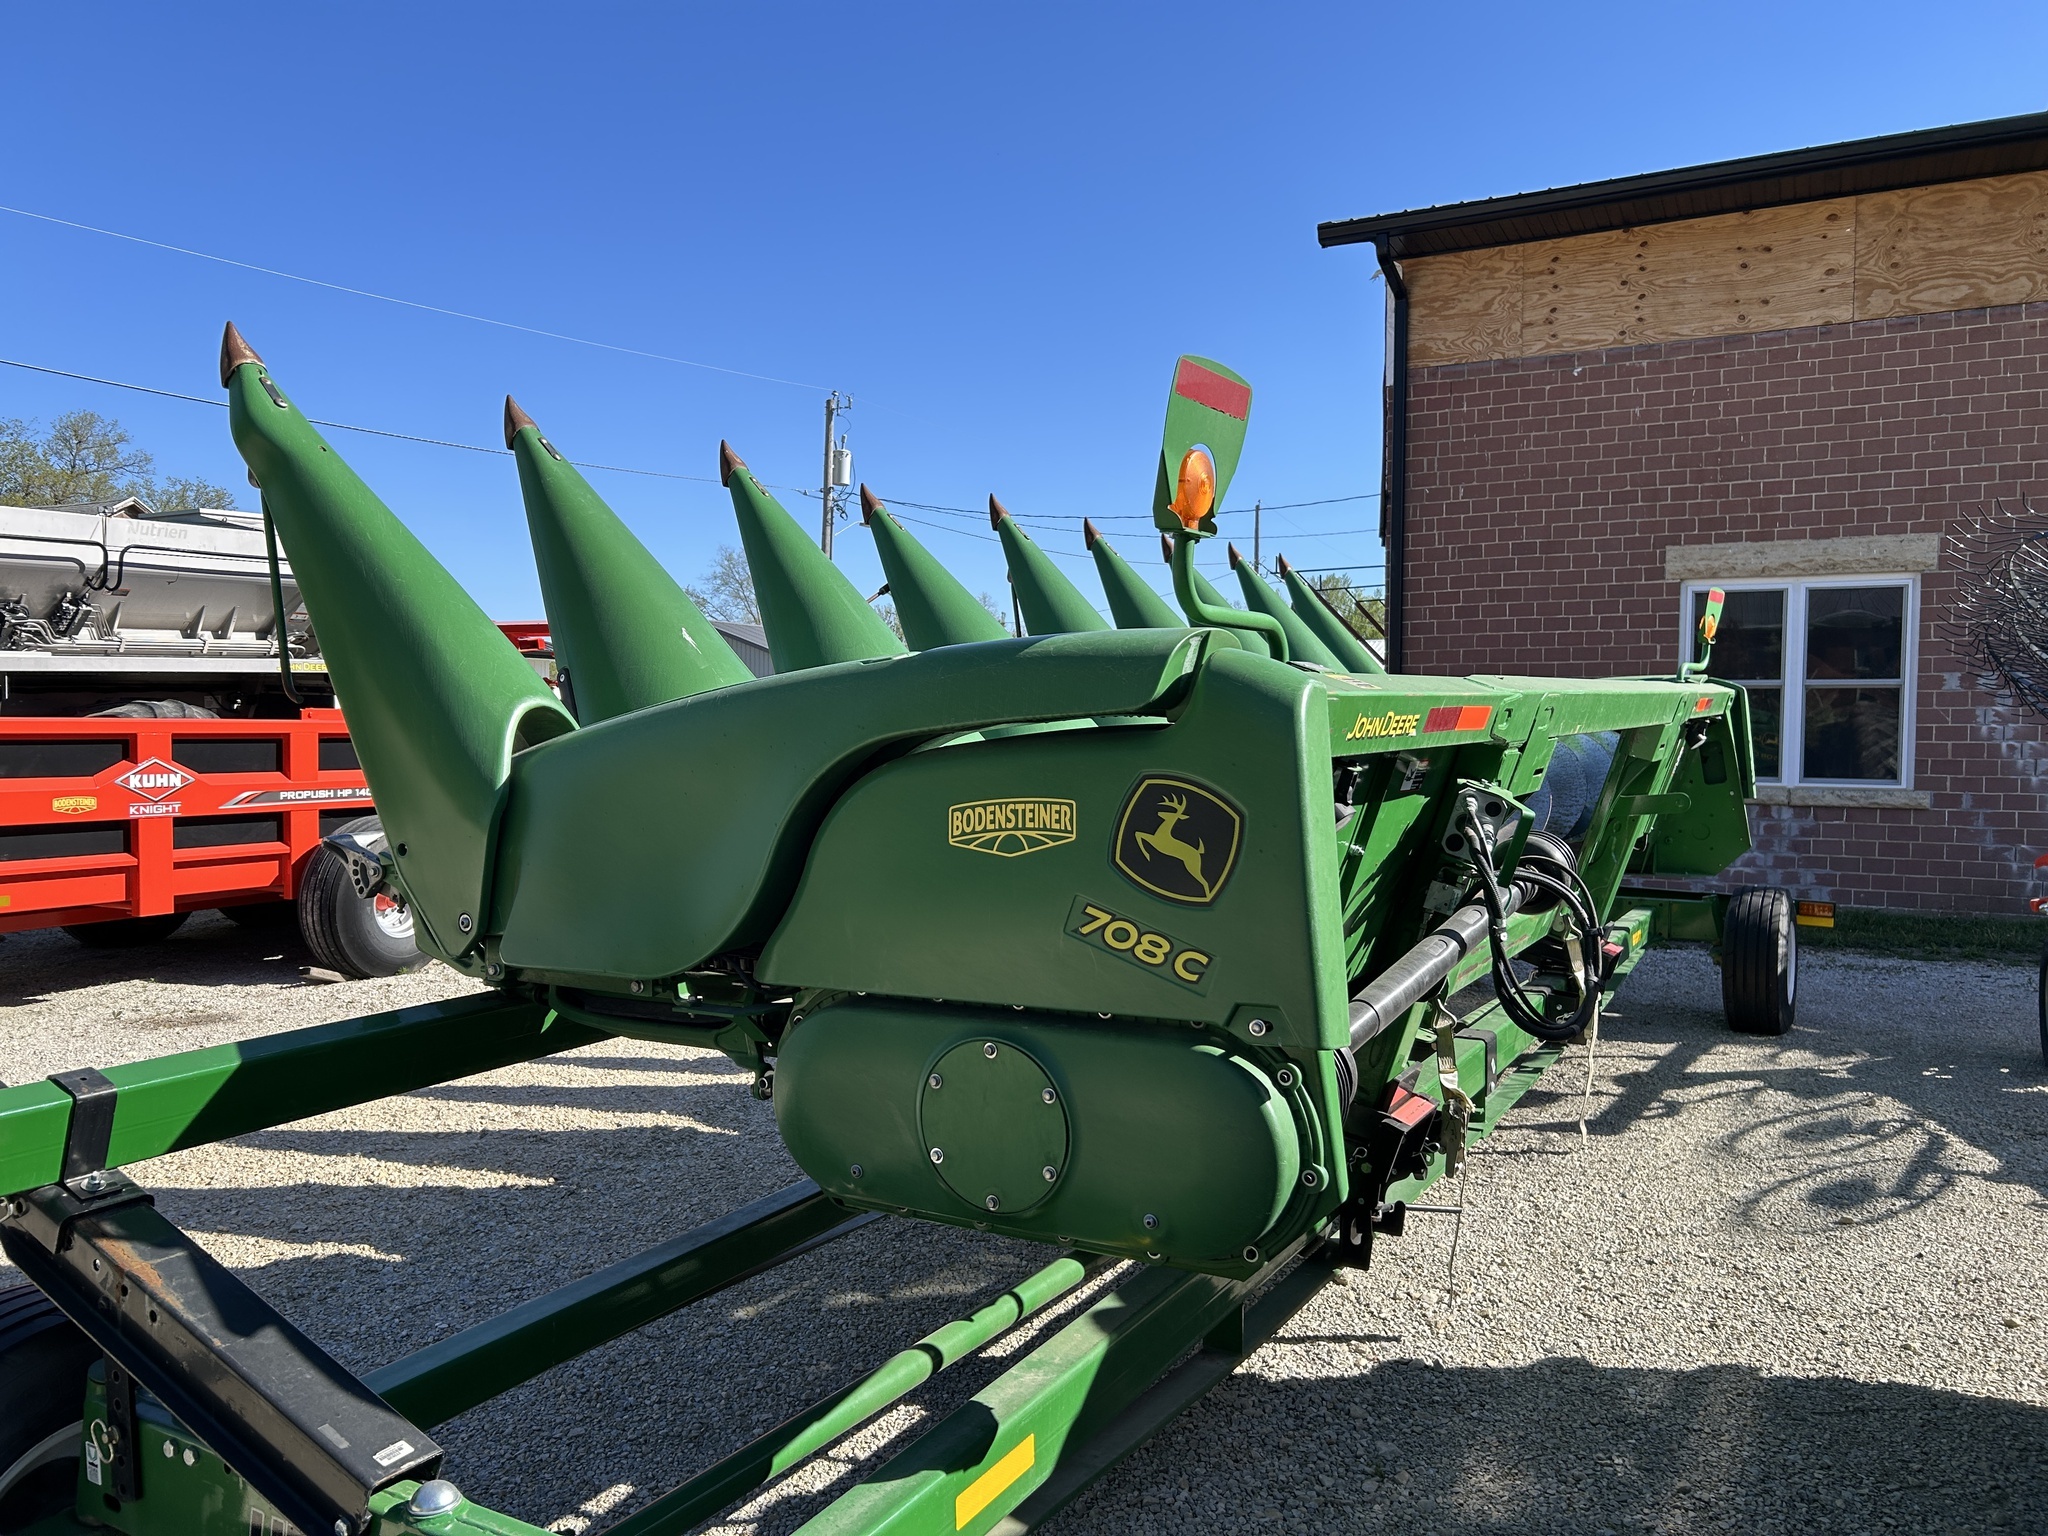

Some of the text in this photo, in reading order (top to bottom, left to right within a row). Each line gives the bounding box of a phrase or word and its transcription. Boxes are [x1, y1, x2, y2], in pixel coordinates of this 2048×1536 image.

[127, 520, 188, 539] Nutrien
[129, 773, 182, 789] KUHN
[280, 789, 334, 800] PROPUSH
[337, 788, 353, 798] HP
[54, 797, 96, 808] BODENSTEINER
[129, 804, 182, 815] KNIGHT
[952, 803, 1073, 836] BODENSTEINER
[1077, 904, 1209, 982] 708 C
